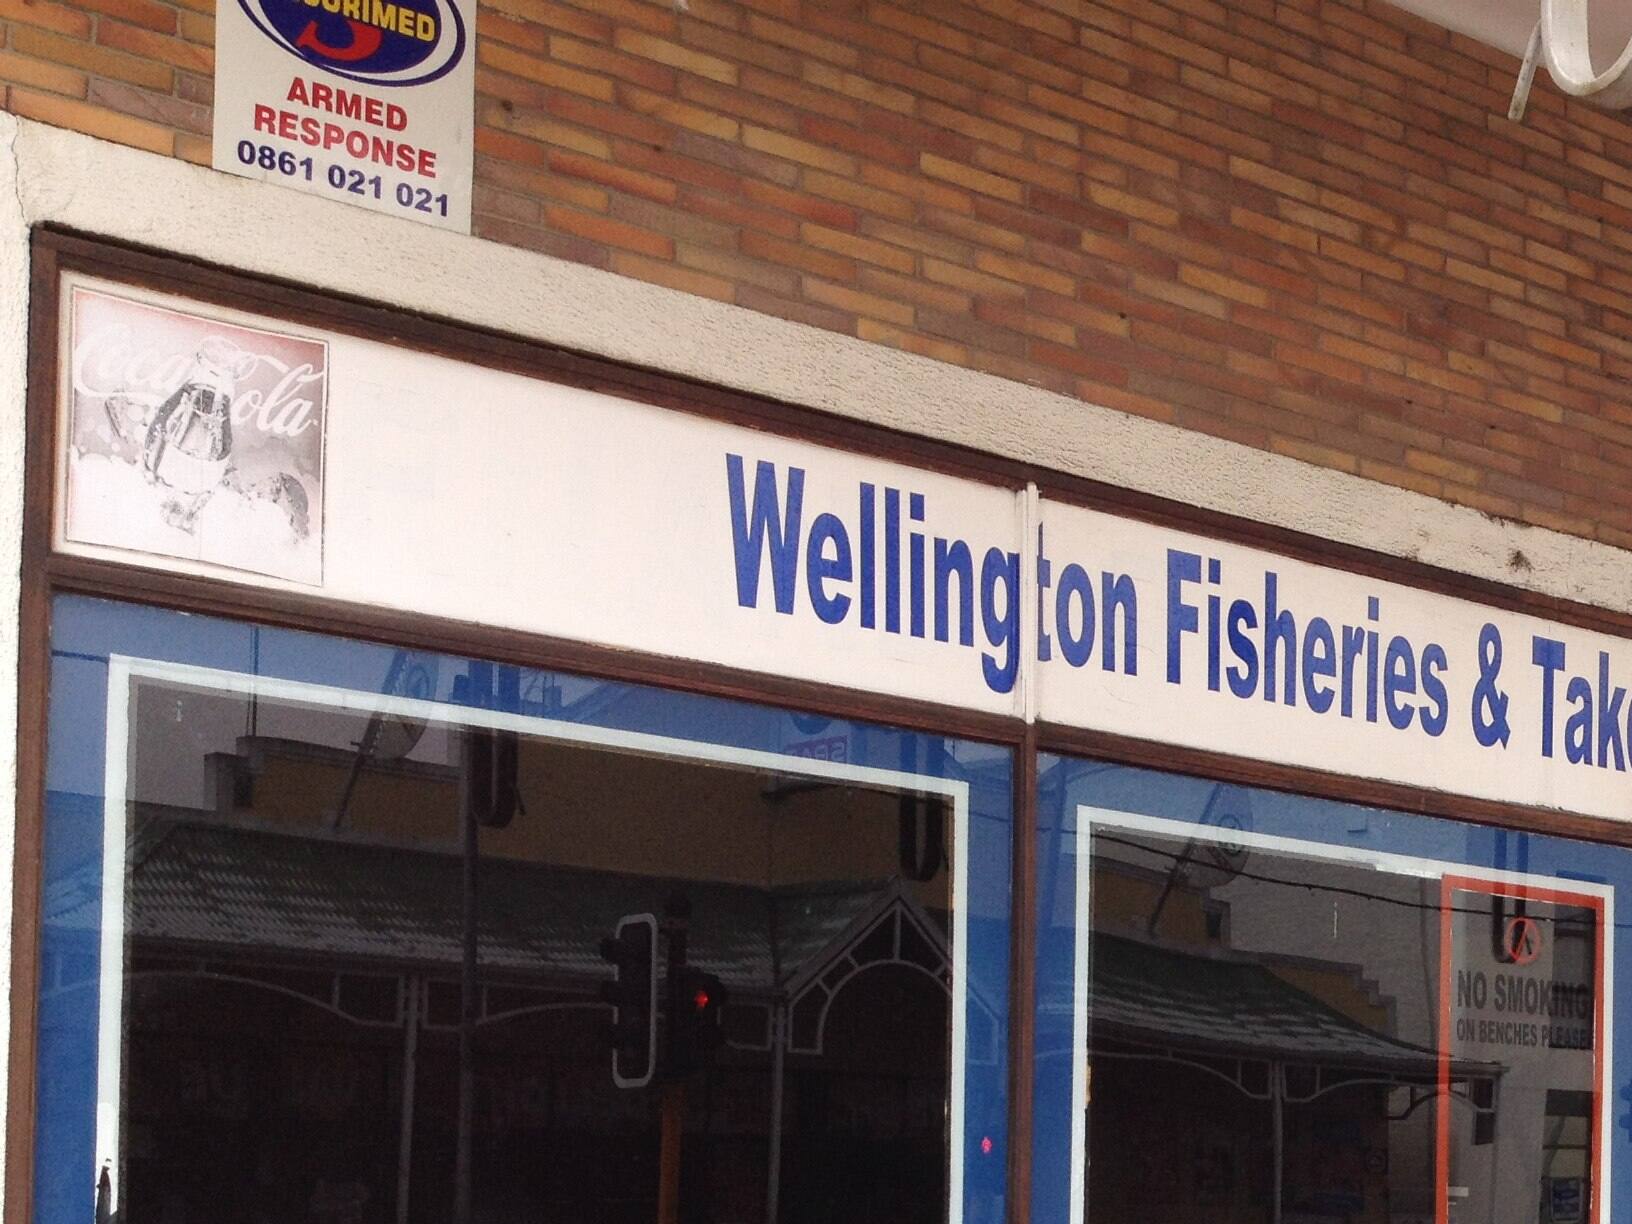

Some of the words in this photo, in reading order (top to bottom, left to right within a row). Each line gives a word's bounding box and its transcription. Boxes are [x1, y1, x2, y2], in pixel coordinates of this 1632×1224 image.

[287, 76, 408, 132] ARMED
[254, 103, 437, 179] RESPONSE
[237, 140, 313, 181] 0861
[328, 164, 382, 199] 021
[396, 183, 448, 217] 021
[725, 453, 1138, 694] Wellington
[1167, 548, 1448, 737] Fisheries
[1471, 622, 1511, 750] &
[1457, 970, 1488, 1010] NO
[1494, 974, 1590, 1020] SMOKING
[1456, 1018, 1475, 1042] ON
[1478, 1020, 1538, 1047] BENCHES
